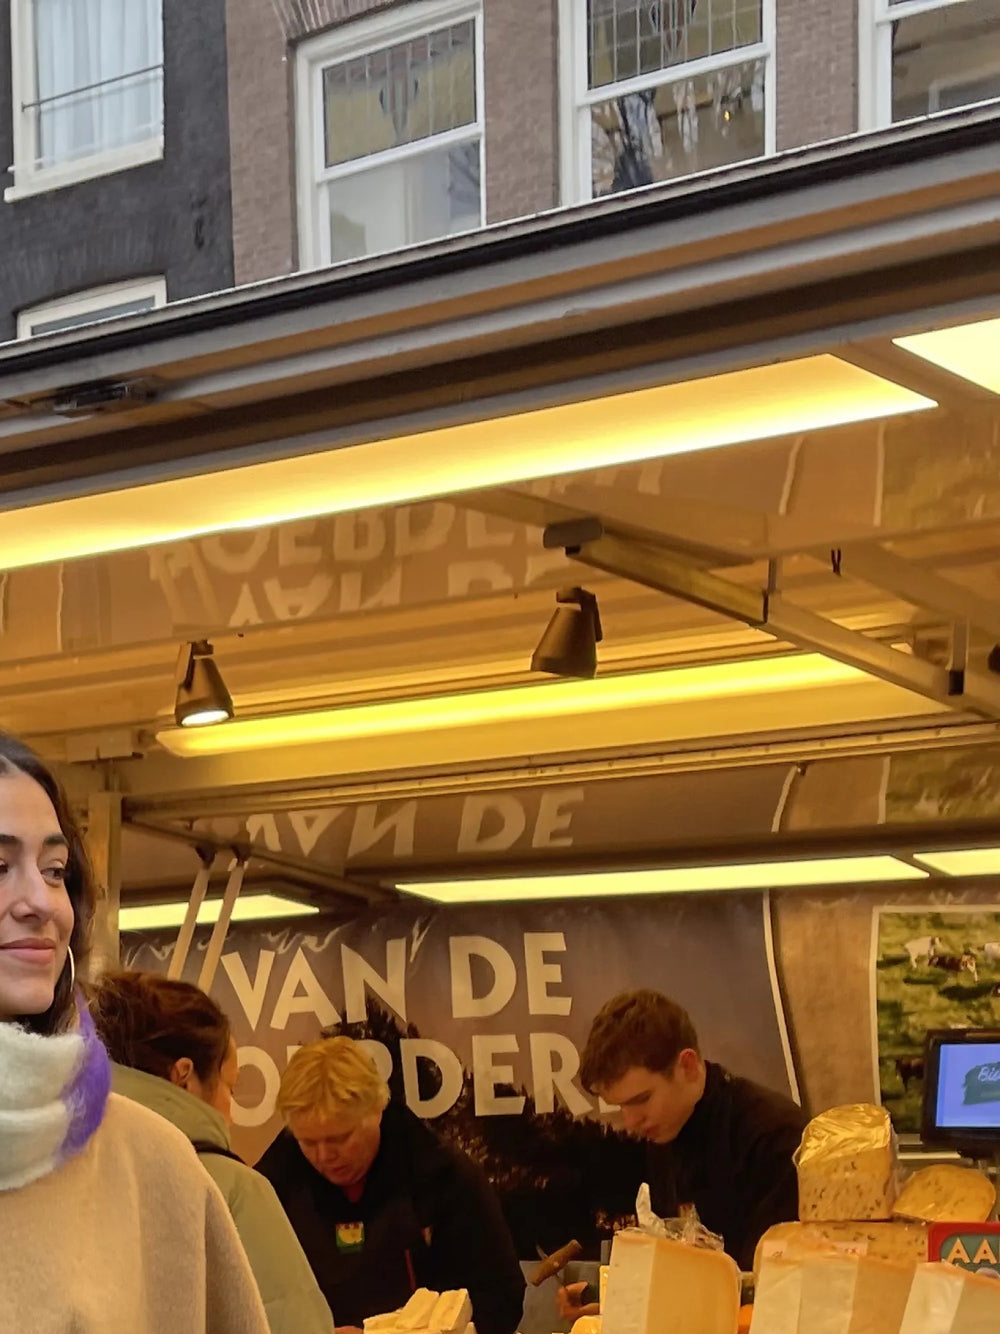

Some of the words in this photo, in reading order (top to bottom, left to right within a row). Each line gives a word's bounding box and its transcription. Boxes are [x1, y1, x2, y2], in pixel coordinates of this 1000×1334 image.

[221, 937, 407, 1030] VAN
[449, 931, 572, 1018] DE
[947, 1237, 1000, 1264] AA
